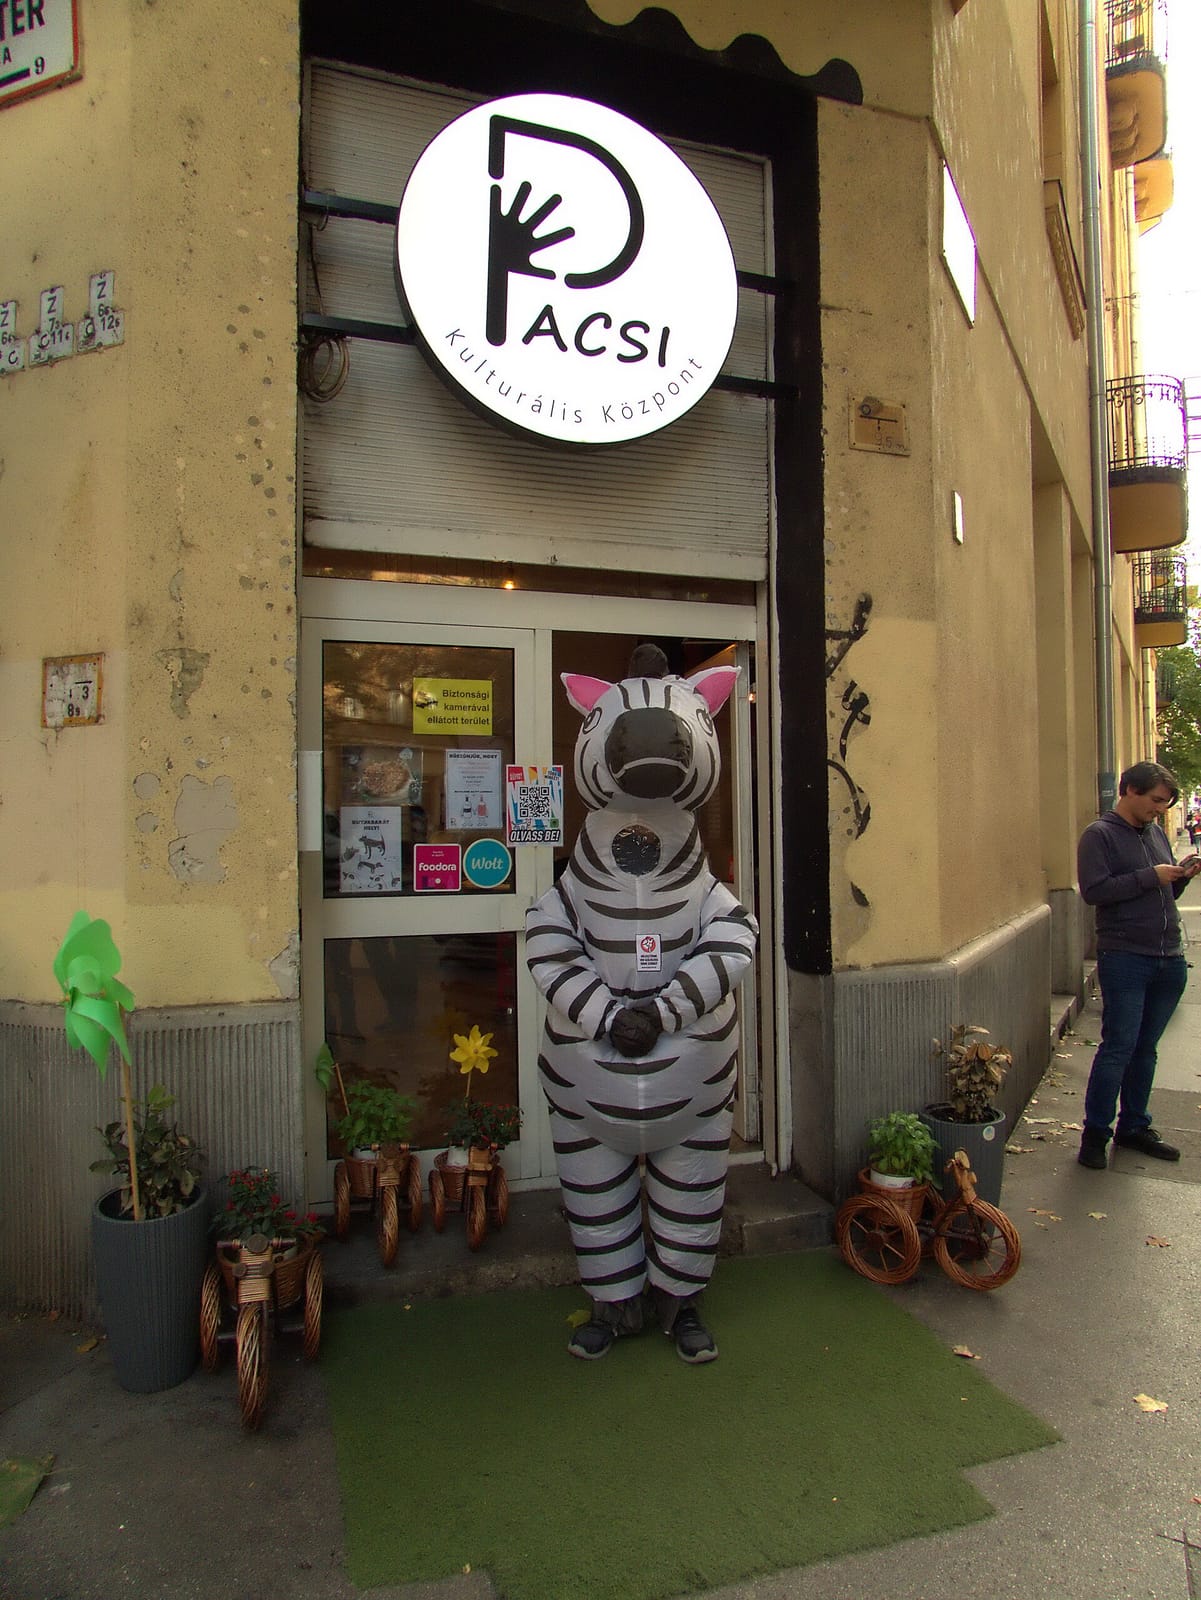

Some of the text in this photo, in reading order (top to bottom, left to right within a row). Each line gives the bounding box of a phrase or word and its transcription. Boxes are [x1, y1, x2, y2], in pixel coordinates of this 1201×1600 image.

[34, 55, 46, 75] 9
[97, 281, 107, 299] Z
[48, 296, 56, 314] Z
[0, 310, 9, 328] Z
[8, 350, 18, 365] C
[444, 327, 704, 425] Kulturális Központ
[82, 686, 90, 700] 3
[442, 689, 490, 701] Biztonsági
[443, 703, 490, 712] kamerával
[427, 715, 490, 725] ellátott terület
[510, 829, 560, 842] OLVASS BE!
[418, 861, 457, 872] foodora
[471, 856, 504, 871] Wolt
